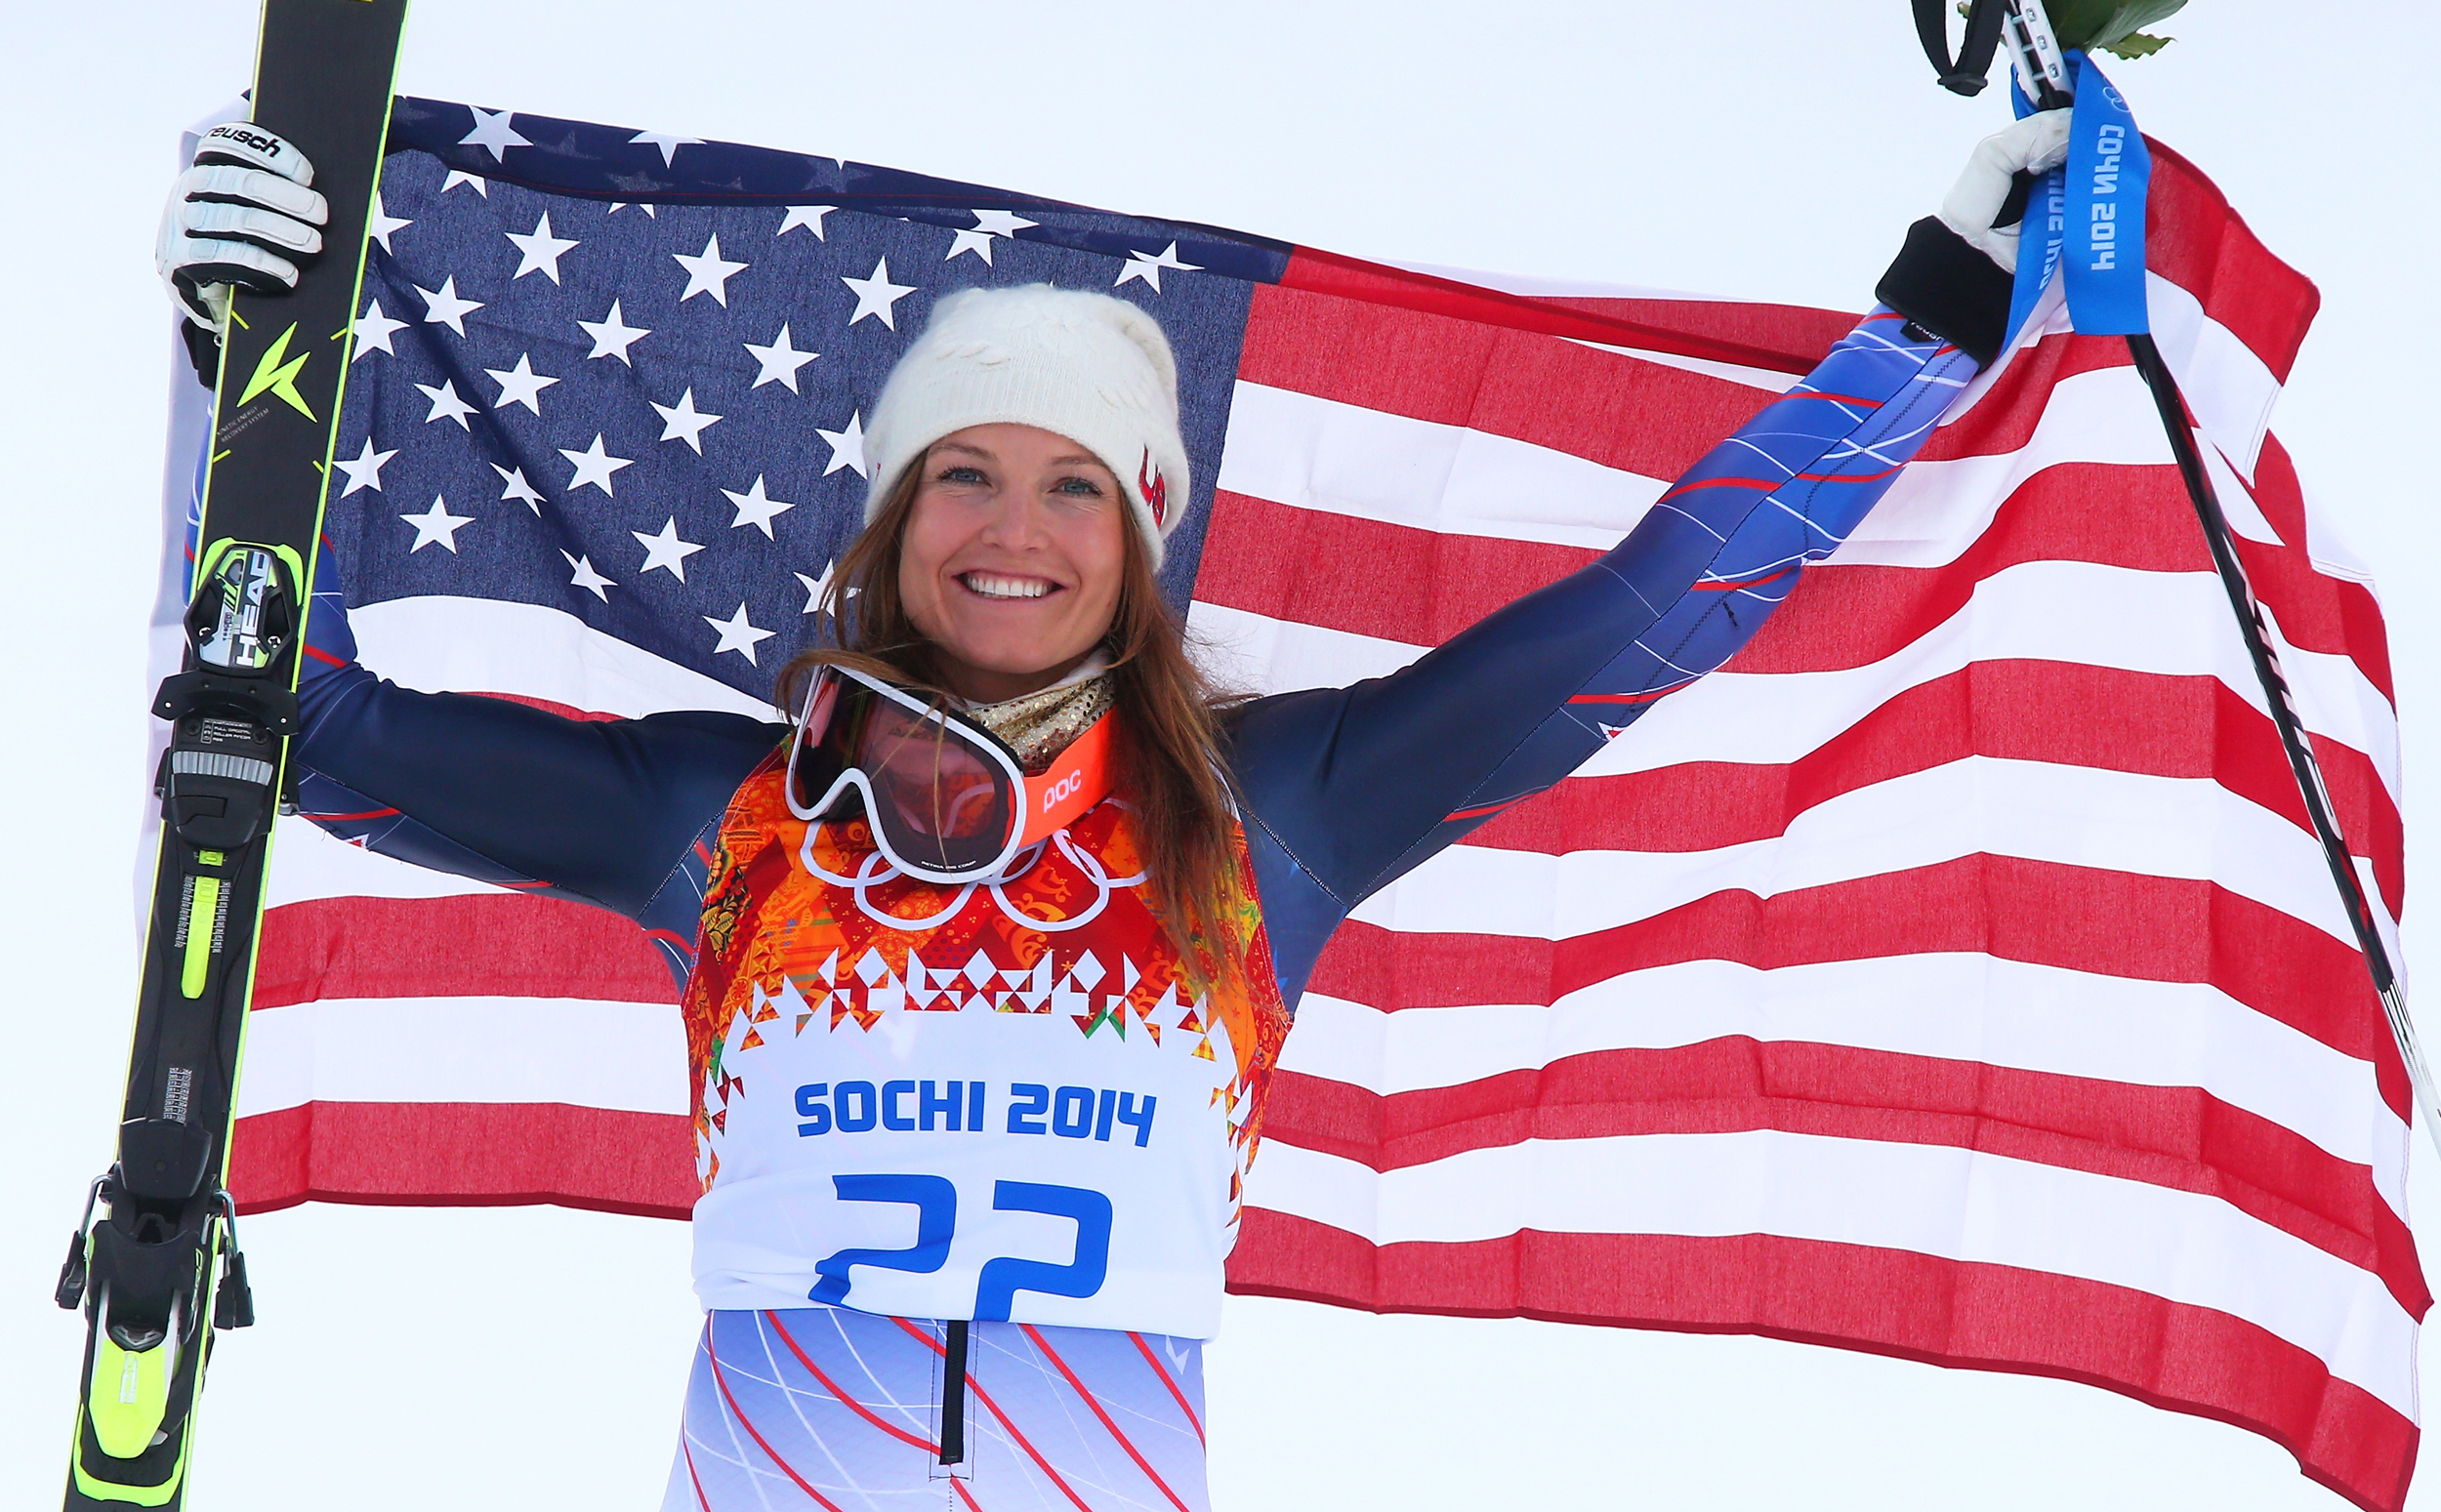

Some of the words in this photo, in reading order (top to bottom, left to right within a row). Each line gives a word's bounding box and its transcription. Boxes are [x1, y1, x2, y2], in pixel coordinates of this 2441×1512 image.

[202, 127, 280, 158] reusch
[2090, 202, 2117, 271] 2014
[235, 552, 270, 667] HEAD
[794, 1080, 986, 1137] SOCHI
[1007, 1083, 1157, 1148] 2014
[807, 1174, 1113, 1323] 22
